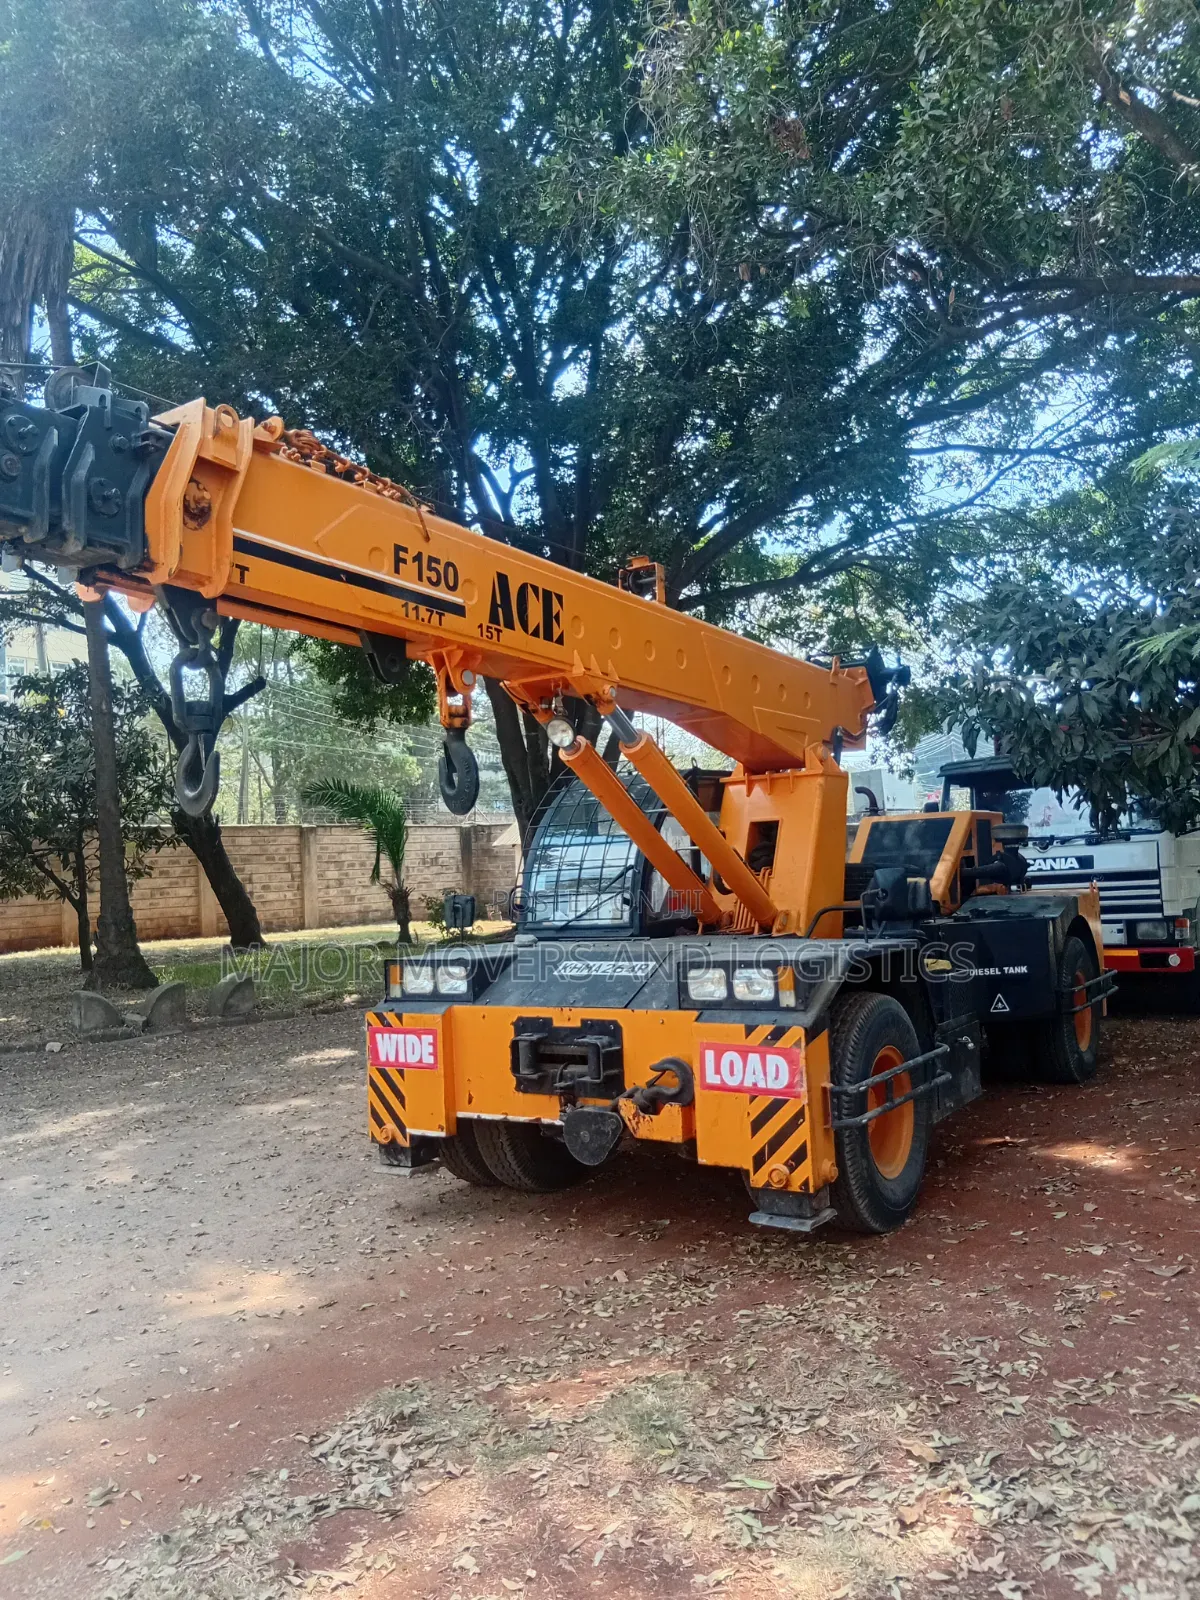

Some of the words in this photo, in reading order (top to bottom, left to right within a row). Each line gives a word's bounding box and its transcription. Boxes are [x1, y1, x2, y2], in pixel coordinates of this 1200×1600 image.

[231, 562, 250, 585] T
[393, 543, 459, 592] F150
[401, 602, 445, 627] 11.7T
[488, 571, 565, 646] ACE
[477, 623, 503, 642] 15T
[1027, 857, 1080, 872] CANIA
[969, 967, 1001, 976] DIESEL
[1003, 965, 1028, 974] TANK
[375, 1033, 435, 1064] WIDE
[704, 1049, 790, 1090] LOAD
